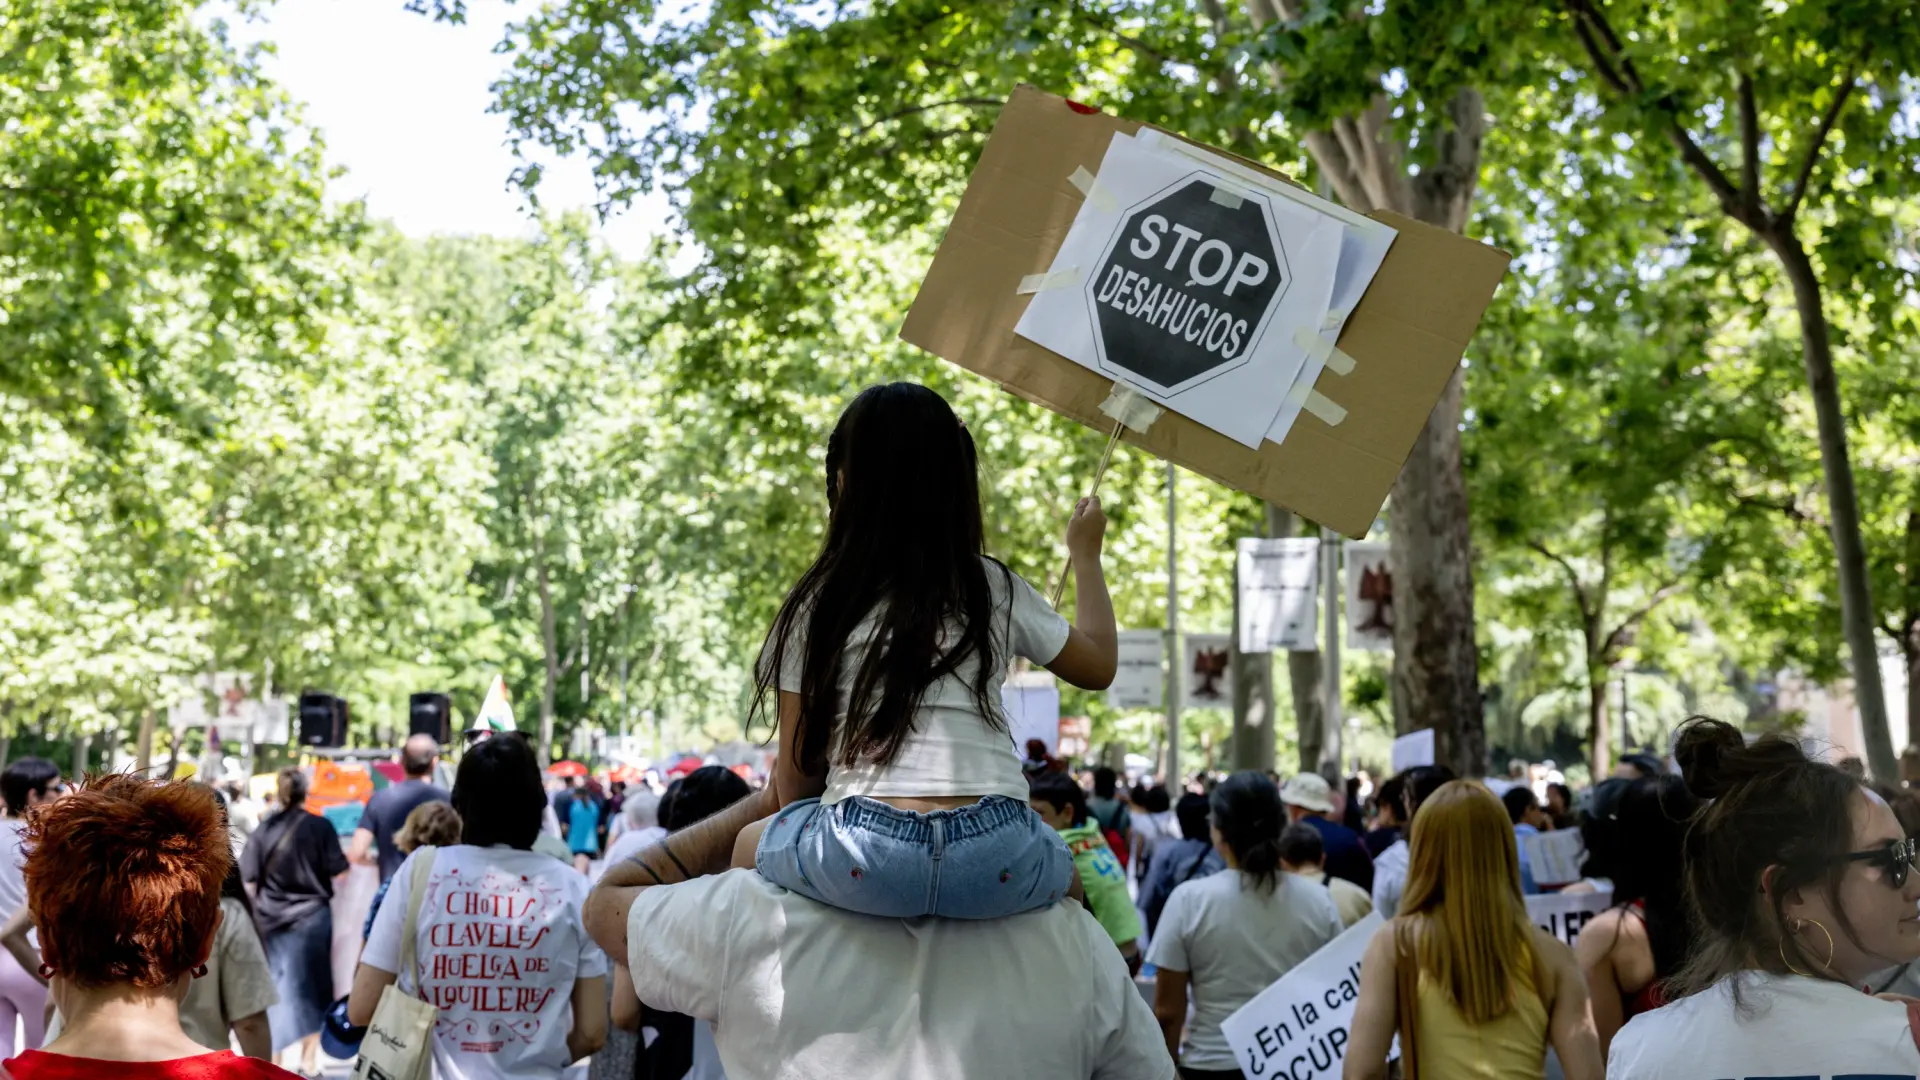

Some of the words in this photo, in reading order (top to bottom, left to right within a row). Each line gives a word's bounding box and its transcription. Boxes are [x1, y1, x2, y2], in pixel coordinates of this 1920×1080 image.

[1129, 213, 1270, 297] STOP
[1097, 264, 1249, 360] DESAHUCIOS
[431, 922, 551, 949] CLAVELES
[433, 953, 521, 980] HUELGA
[524, 957, 549, 972] DE
[1248, 1022, 1293, 1075] ¿En
[1292, 1002, 1320, 1031] la
[1324, 960, 1362, 1010] cal
